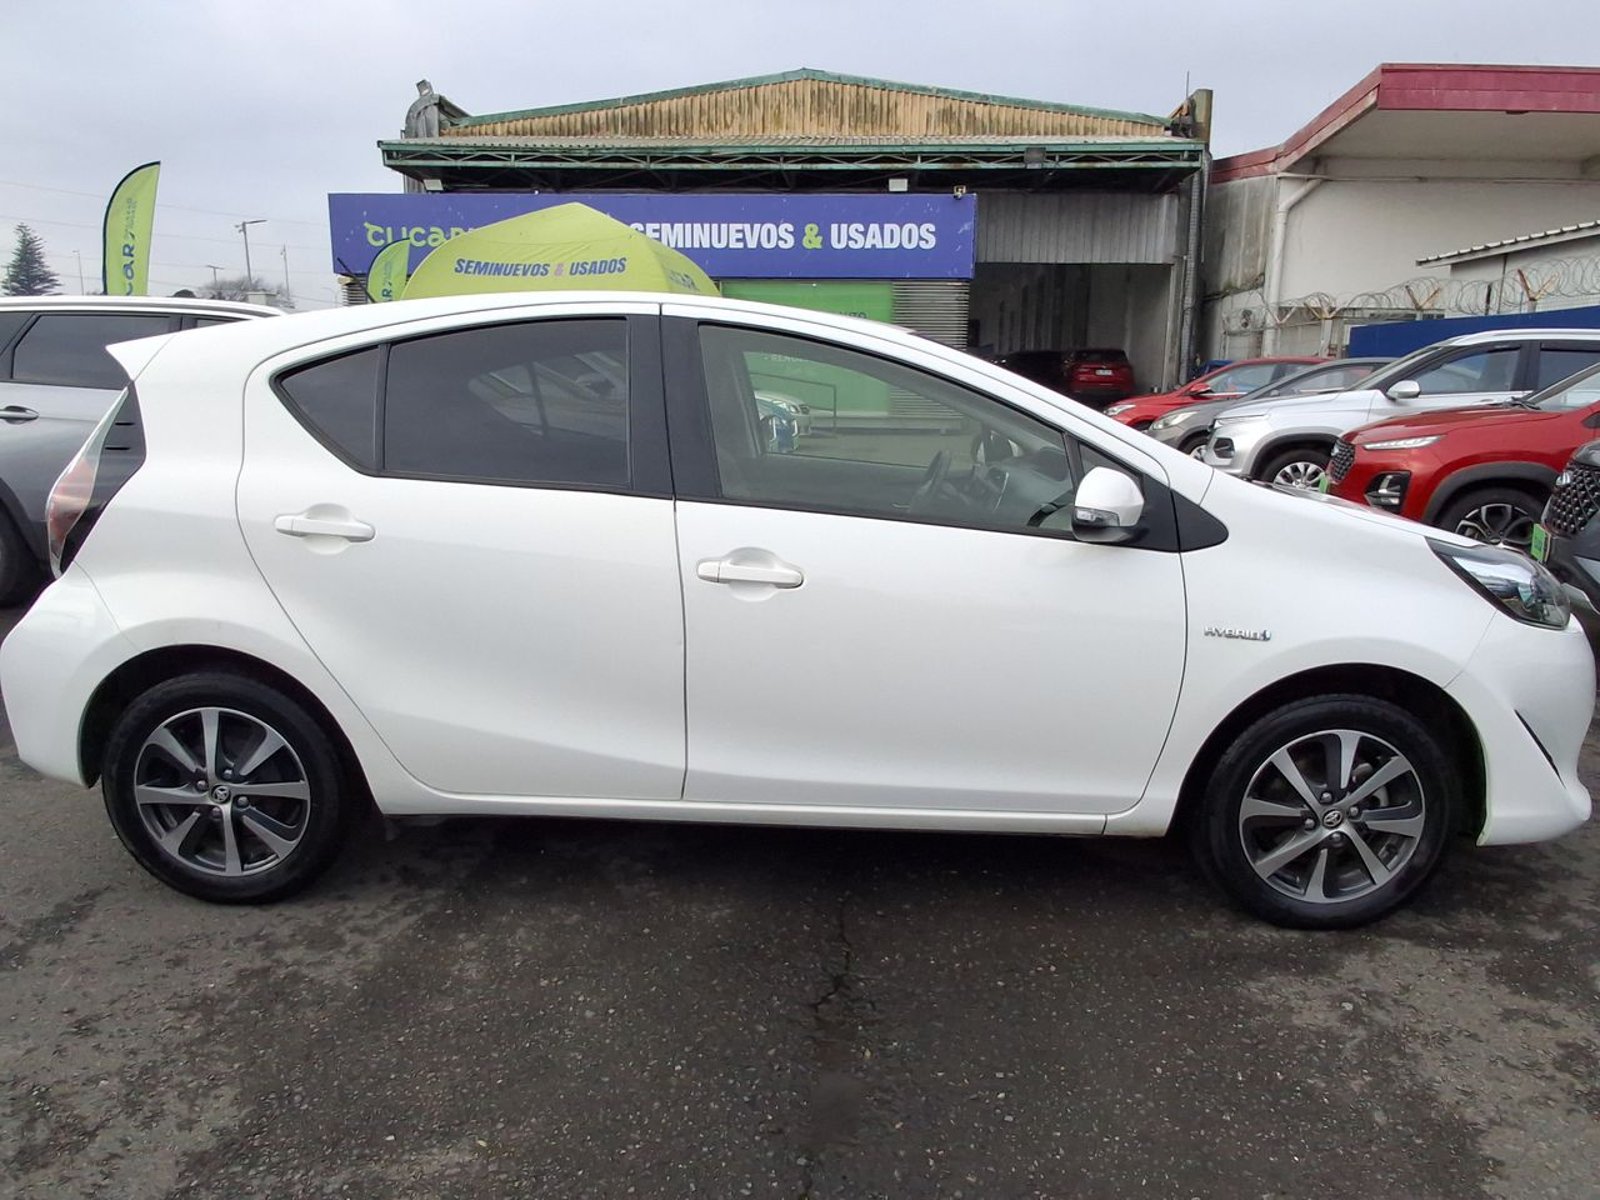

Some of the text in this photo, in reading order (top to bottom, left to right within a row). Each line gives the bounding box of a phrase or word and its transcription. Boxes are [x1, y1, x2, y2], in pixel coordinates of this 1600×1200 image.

[802, 223, 823, 250] &
[830, 223, 937, 250] USADOS
[454, 258, 551, 277] SEMINUEVOS
[569, 257, 627, 276] USADOS
